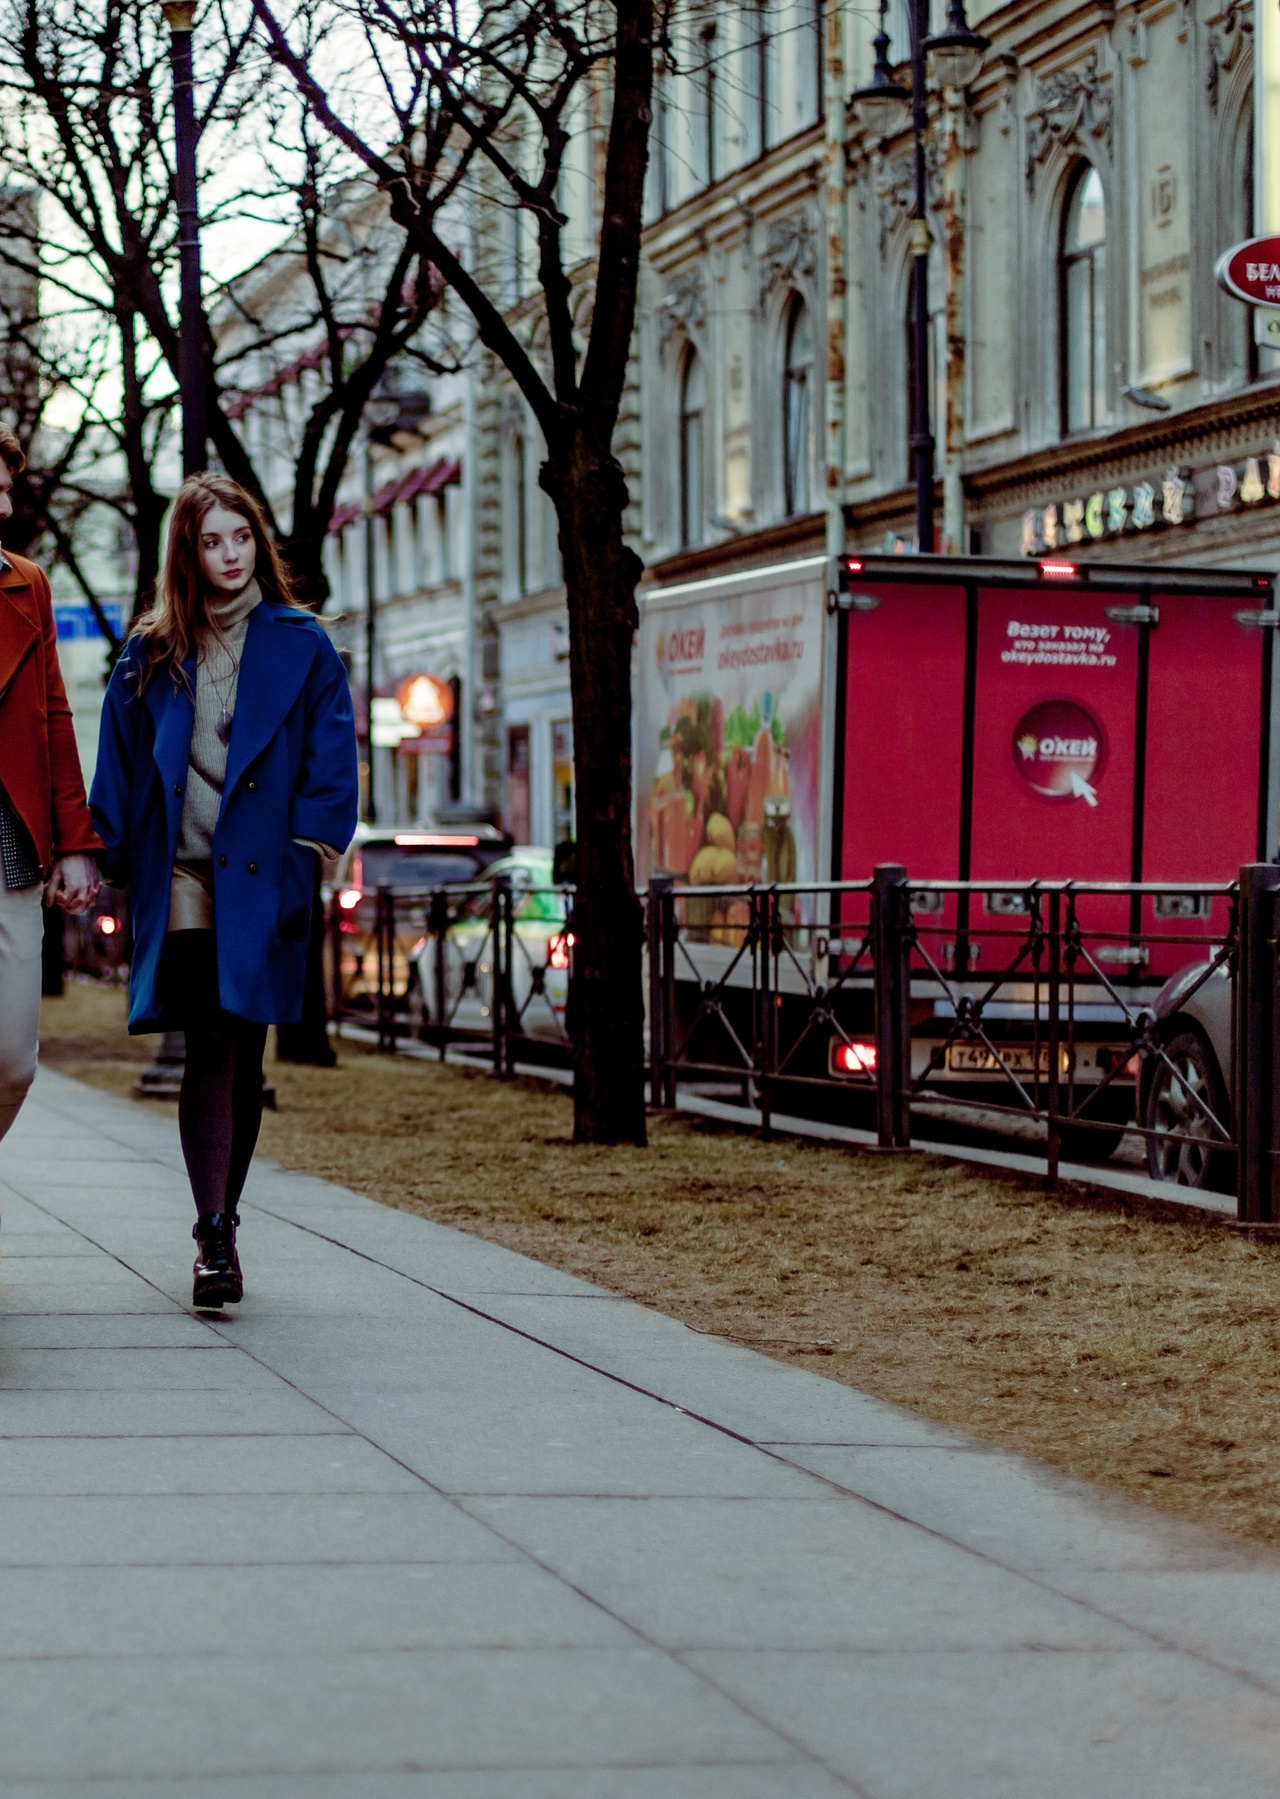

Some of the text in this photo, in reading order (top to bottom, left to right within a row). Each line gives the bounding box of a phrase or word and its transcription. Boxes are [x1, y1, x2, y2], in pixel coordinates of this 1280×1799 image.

[1006, 620, 1111, 644] Везет тому,
[1001, 649, 1118, 667] okeydostavka.ru
